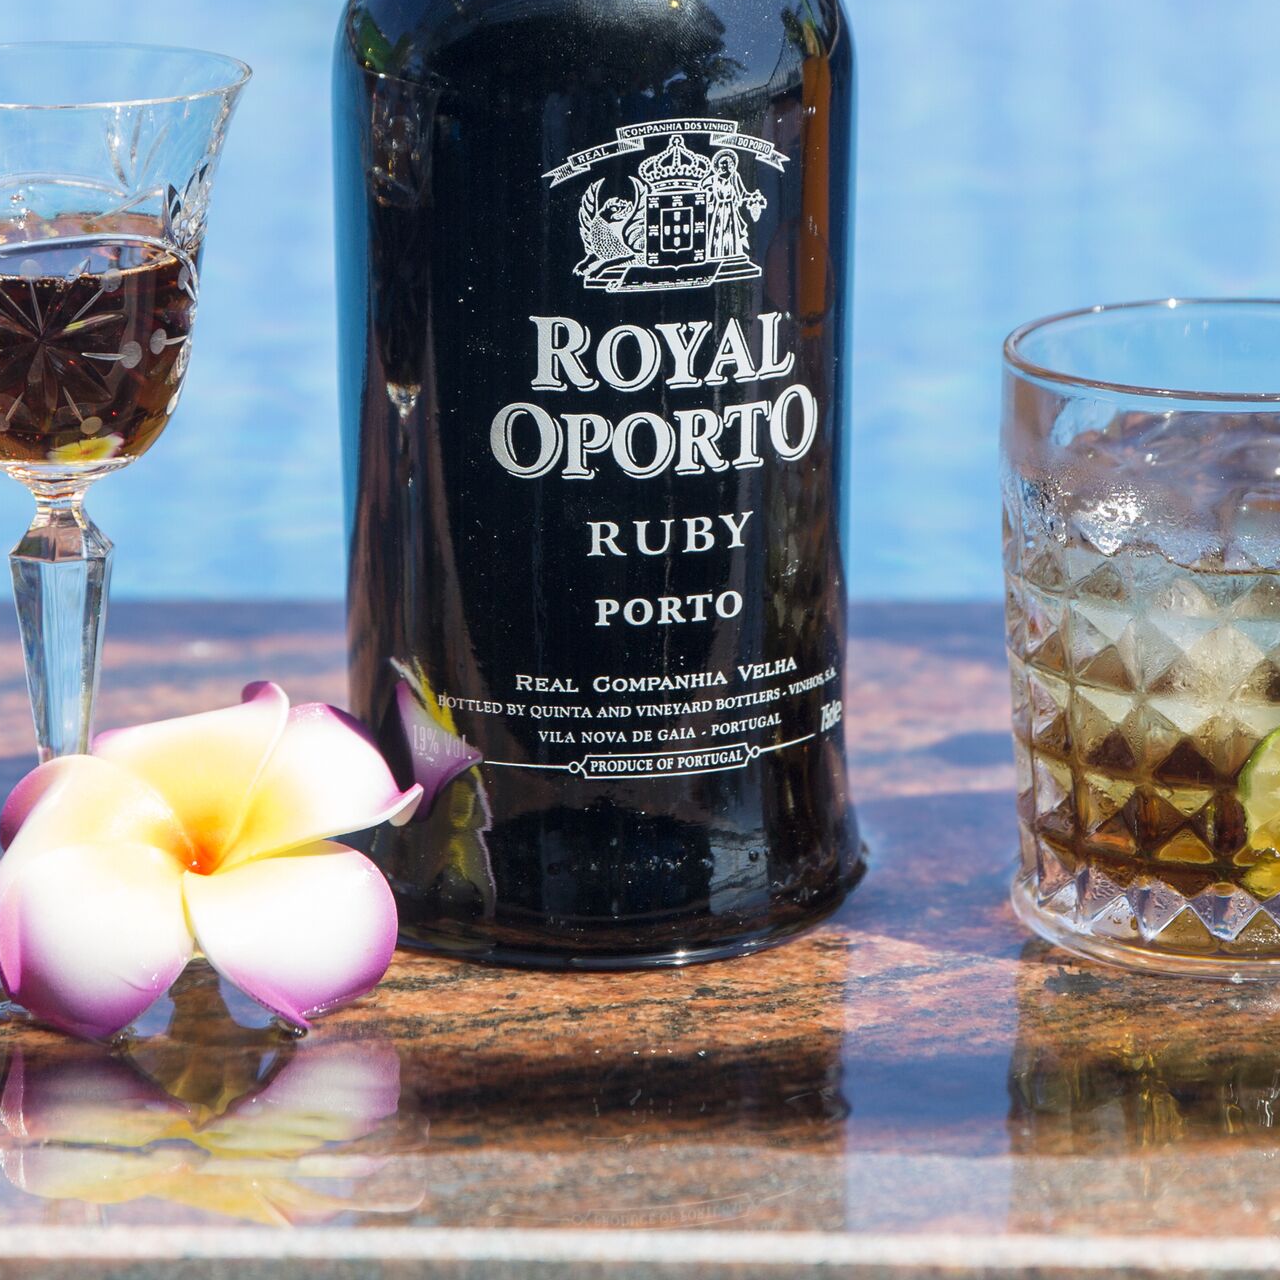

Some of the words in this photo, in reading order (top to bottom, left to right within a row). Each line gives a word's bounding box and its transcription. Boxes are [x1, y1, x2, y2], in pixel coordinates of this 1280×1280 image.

[577, 148, 609, 163] REAL
[624, 123, 682, 137] COMPANHIA
[684, 122, 701, 130] DOS
[703, 122, 733, 132] VINHOS
[737, 137, 749, 147] DO
[529, 312, 795, 392] ROYAL
[490, 384, 818, 480] OPORTO
[586, 511, 754, 556] RUBY
[595, 590, 743, 626] PORTO
[515, 675, 579, 693] REAL
[593, 671, 728, 692] COMPANHIA
[737, 656, 798, 682] VELHA
[437, 694, 503, 714] BOTTLED
[507, 703, 526, 716] BY
[530, 705, 593, 719] QUINTA
[596, 706, 632, 718] AND
[636, 700, 713, 717] VINEYARD
[716, 687, 781, 711] BOTTLERS
[413, 724, 439, 755] 19%
[538, 730, 576, 744] VILA
[581, 731, 627, 743] NOVA
[632, 729, 653, 742] DE
[657, 726, 697, 740] GAIA
[711, 712, 782, 737] PORTUGAL
[590, 759, 653, 772] PRODUCE
[656, 758, 674, 770] OF
[677, 749, 743, 769] PORTUGAL
